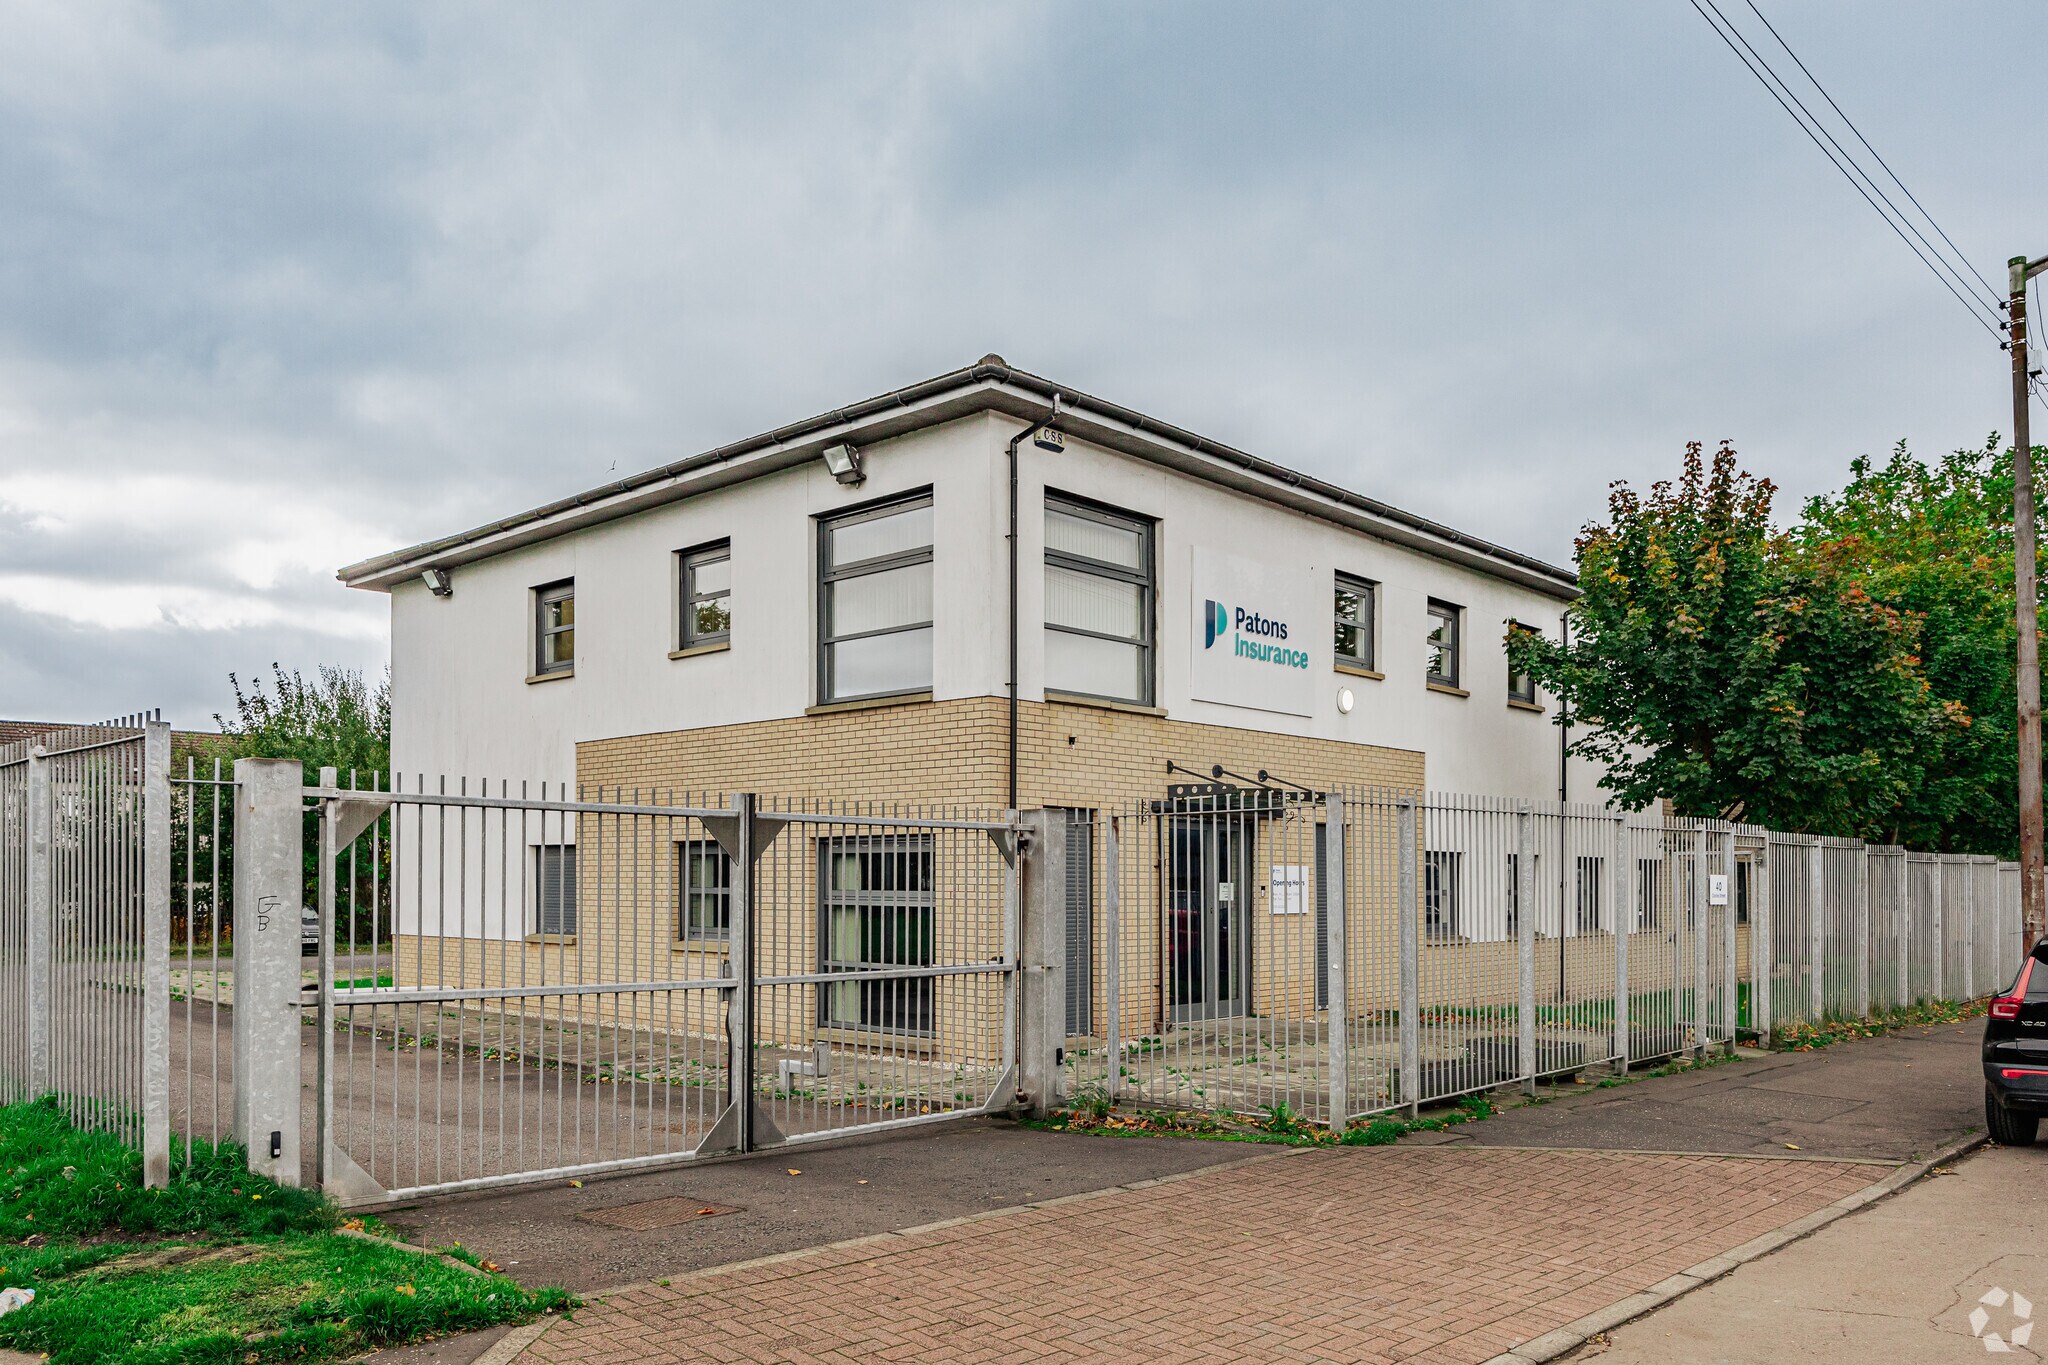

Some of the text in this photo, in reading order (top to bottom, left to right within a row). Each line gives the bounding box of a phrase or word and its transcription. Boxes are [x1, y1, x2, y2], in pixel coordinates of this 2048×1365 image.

[1235, 606, 1288, 640] Patons
[1235, 632, 1309, 669] Insurance
[1272, 879, 1292, 887] Openng
[1715, 881, 1723, 891] 40
